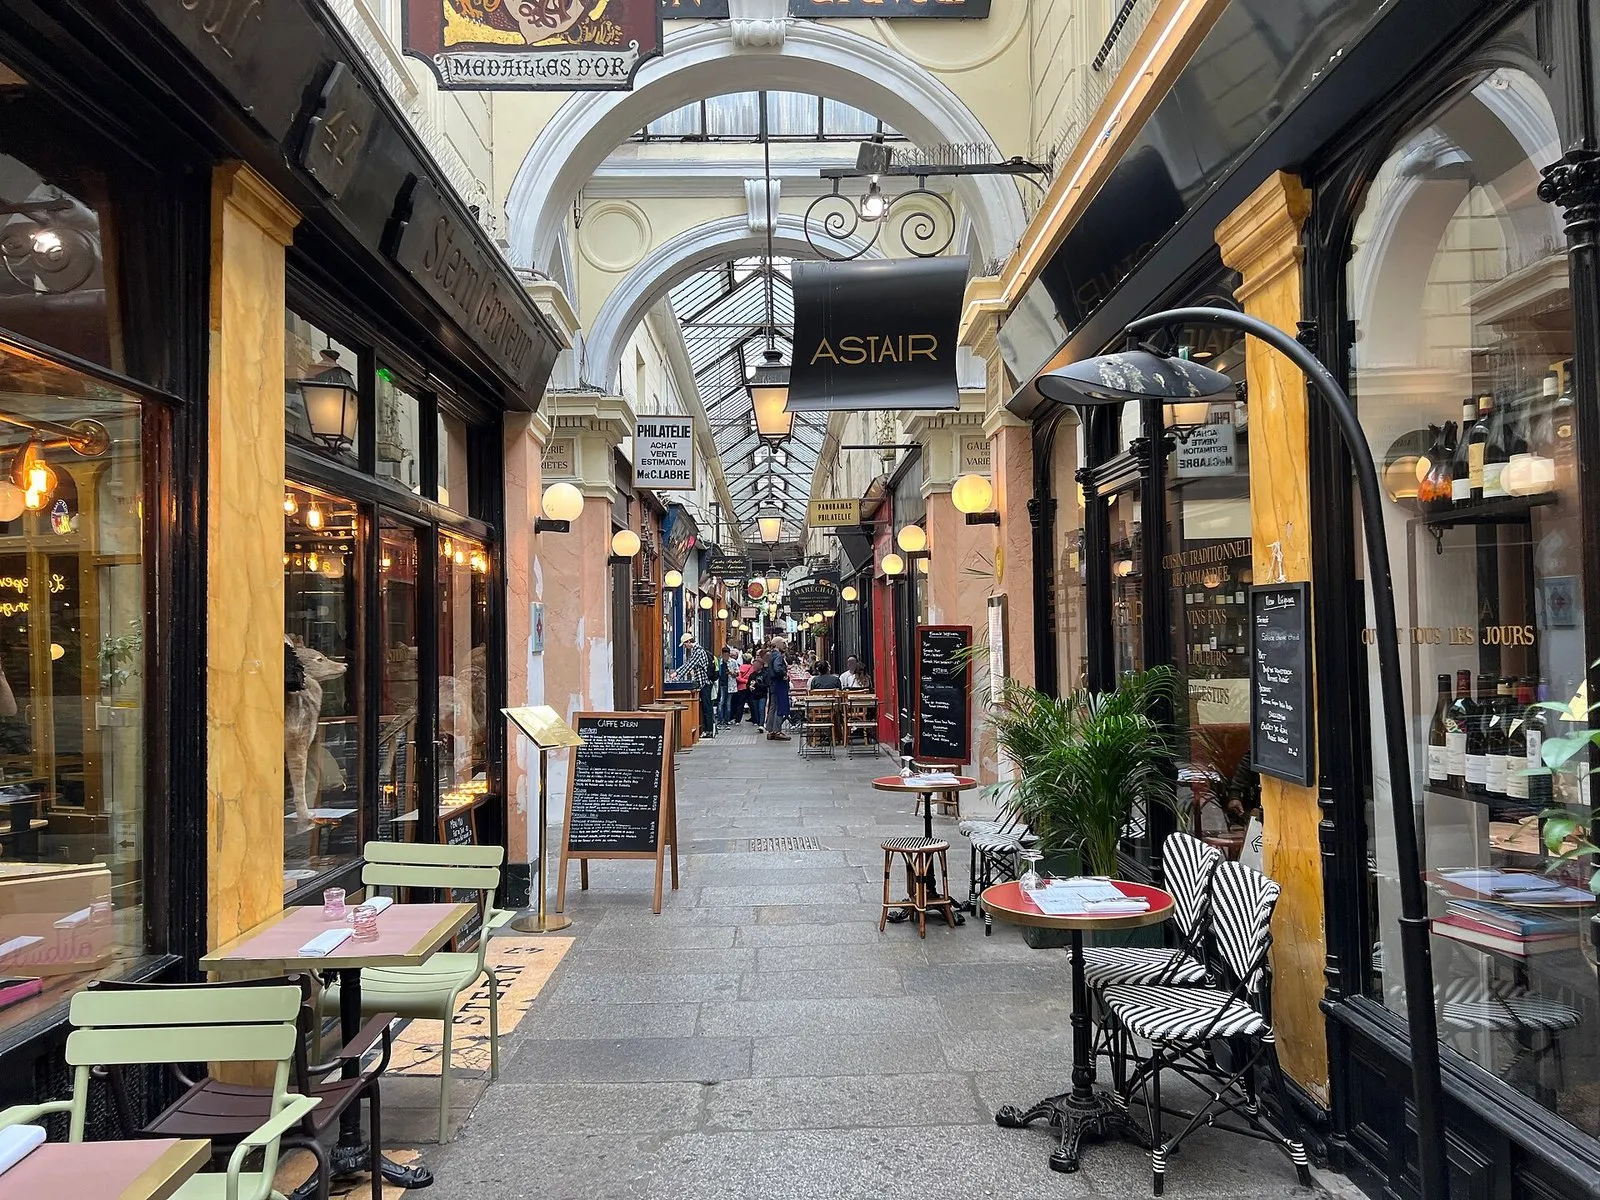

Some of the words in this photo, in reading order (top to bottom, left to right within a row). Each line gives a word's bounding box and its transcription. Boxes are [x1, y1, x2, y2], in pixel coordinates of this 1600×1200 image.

[453, 57, 571, 77] MEDAILLES
[577, 56, 629, 76] D'OR
[423, 214, 479, 314] Stern
[476, 280, 533, 370] Graveur
[809, 334, 938, 366] ASTAIR
[540, 445, 564, 454] LERIE
[966, 441, 990, 450] GALE
[641, 458, 686, 466] ESTIMATION
[966, 457, 990, 465] VARIE
[1162, 552, 1188, 570] CUISINE
[1189, 539, 1252, 566] TRADITIONNELL
[1186, 610, 1206, 625] VINS
[1208, 609, 1227, 625] FINS
[1409, 627, 1442, 645] TOUS
[1449, 626, 1475, 645] LES
[1482, 625, 1535, 646] JOURS
[1187, 650, 1228, 667] LIQUEURS
[452, 964, 526, 1025] STERN
